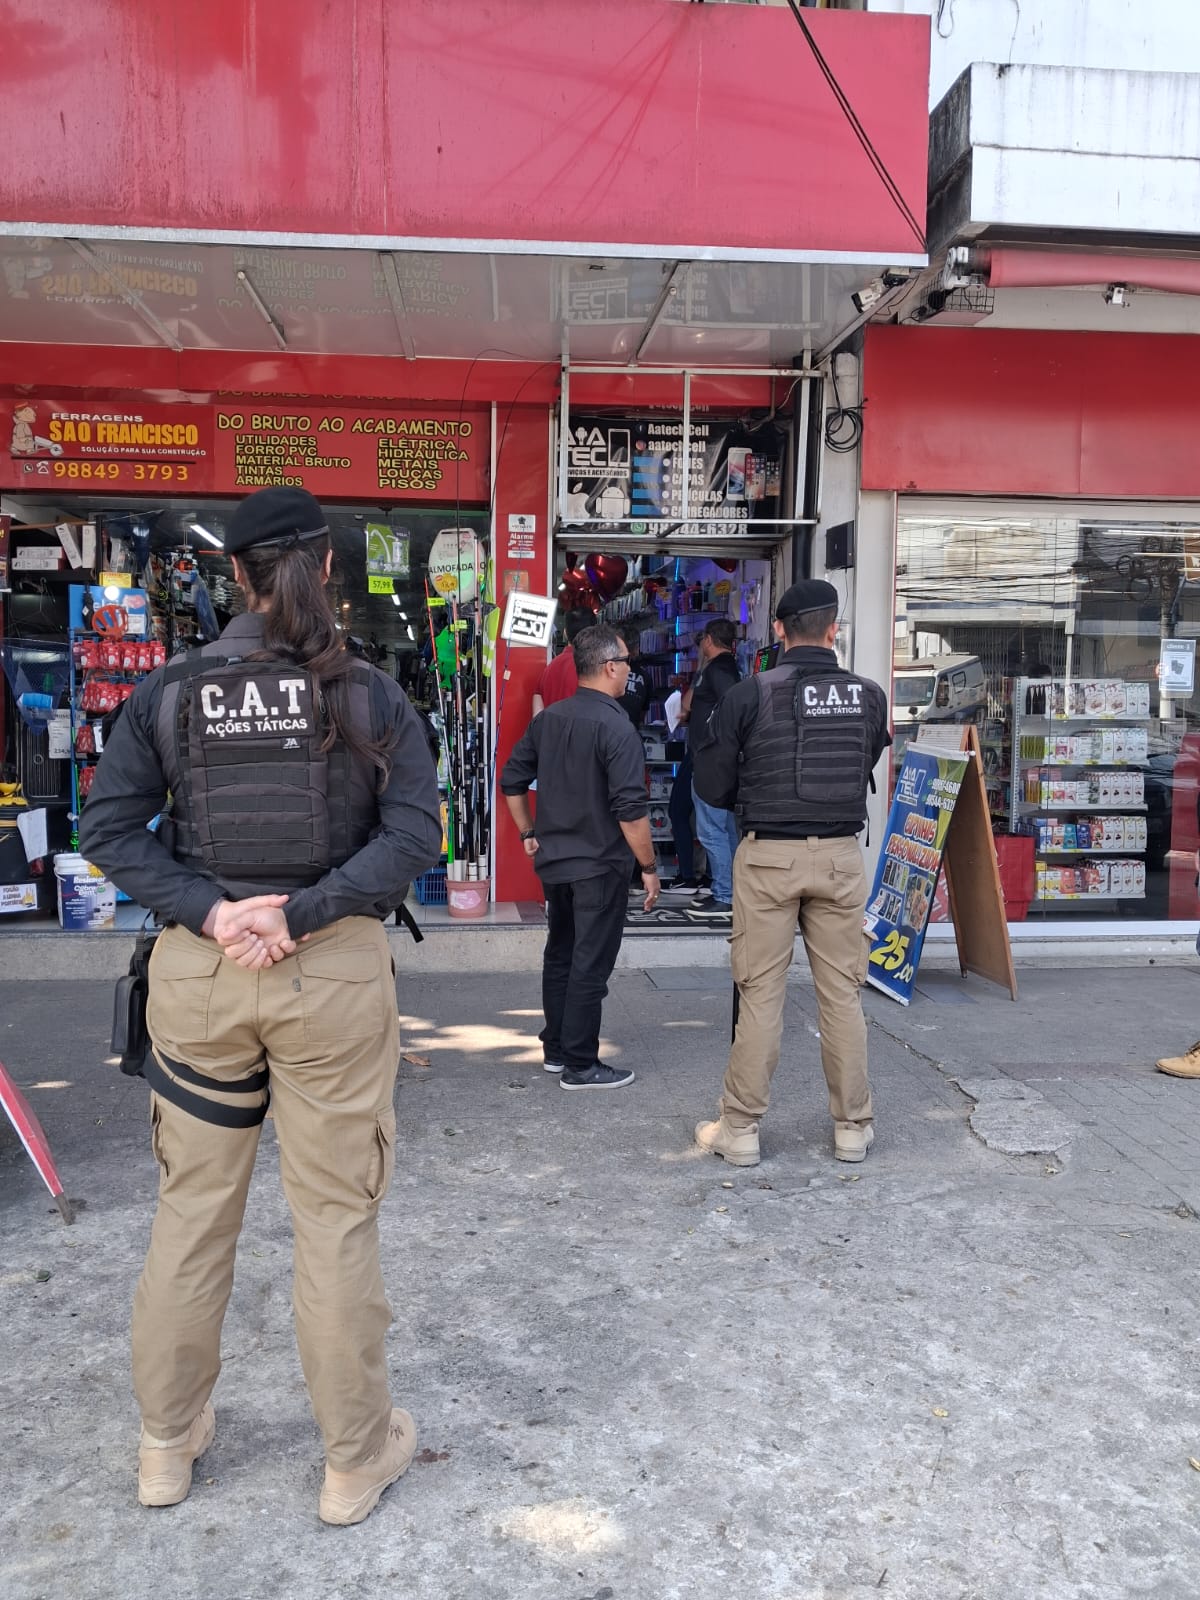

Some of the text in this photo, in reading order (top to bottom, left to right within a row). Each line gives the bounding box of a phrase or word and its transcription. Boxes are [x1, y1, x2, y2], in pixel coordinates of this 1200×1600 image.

[52, 412, 143, 422] FERRAGENS
[218, 413, 472, 436] DO BRUTO AO ACABAMENTO
[97, 423, 198, 445] FRANCISCO
[236, 434, 317, 446] UTILIDADES
[81, 445, 119, 454] SOLUÇÃO
[236, 444, 317, 456] FORRO PVC
[379, 437, 456, 450] ELÉTRICA
[236, 455, 351, 468] MATERIAL BRUTO
[378, 458, 438, 469] METAIS
[54, 461, 188, 481] 98849 3793
[236, 464, 283, 476] TINTAS
[379, 477, 437, 490] PISOS
[201, 679, 306, 718] C.A.T
[804, 684, 862, 706] C.A.T
[806, 706, 862, 716] AÇÕES TÁTICAS
[206, 717, 308, 737] AÇÕES TÁTICAS
